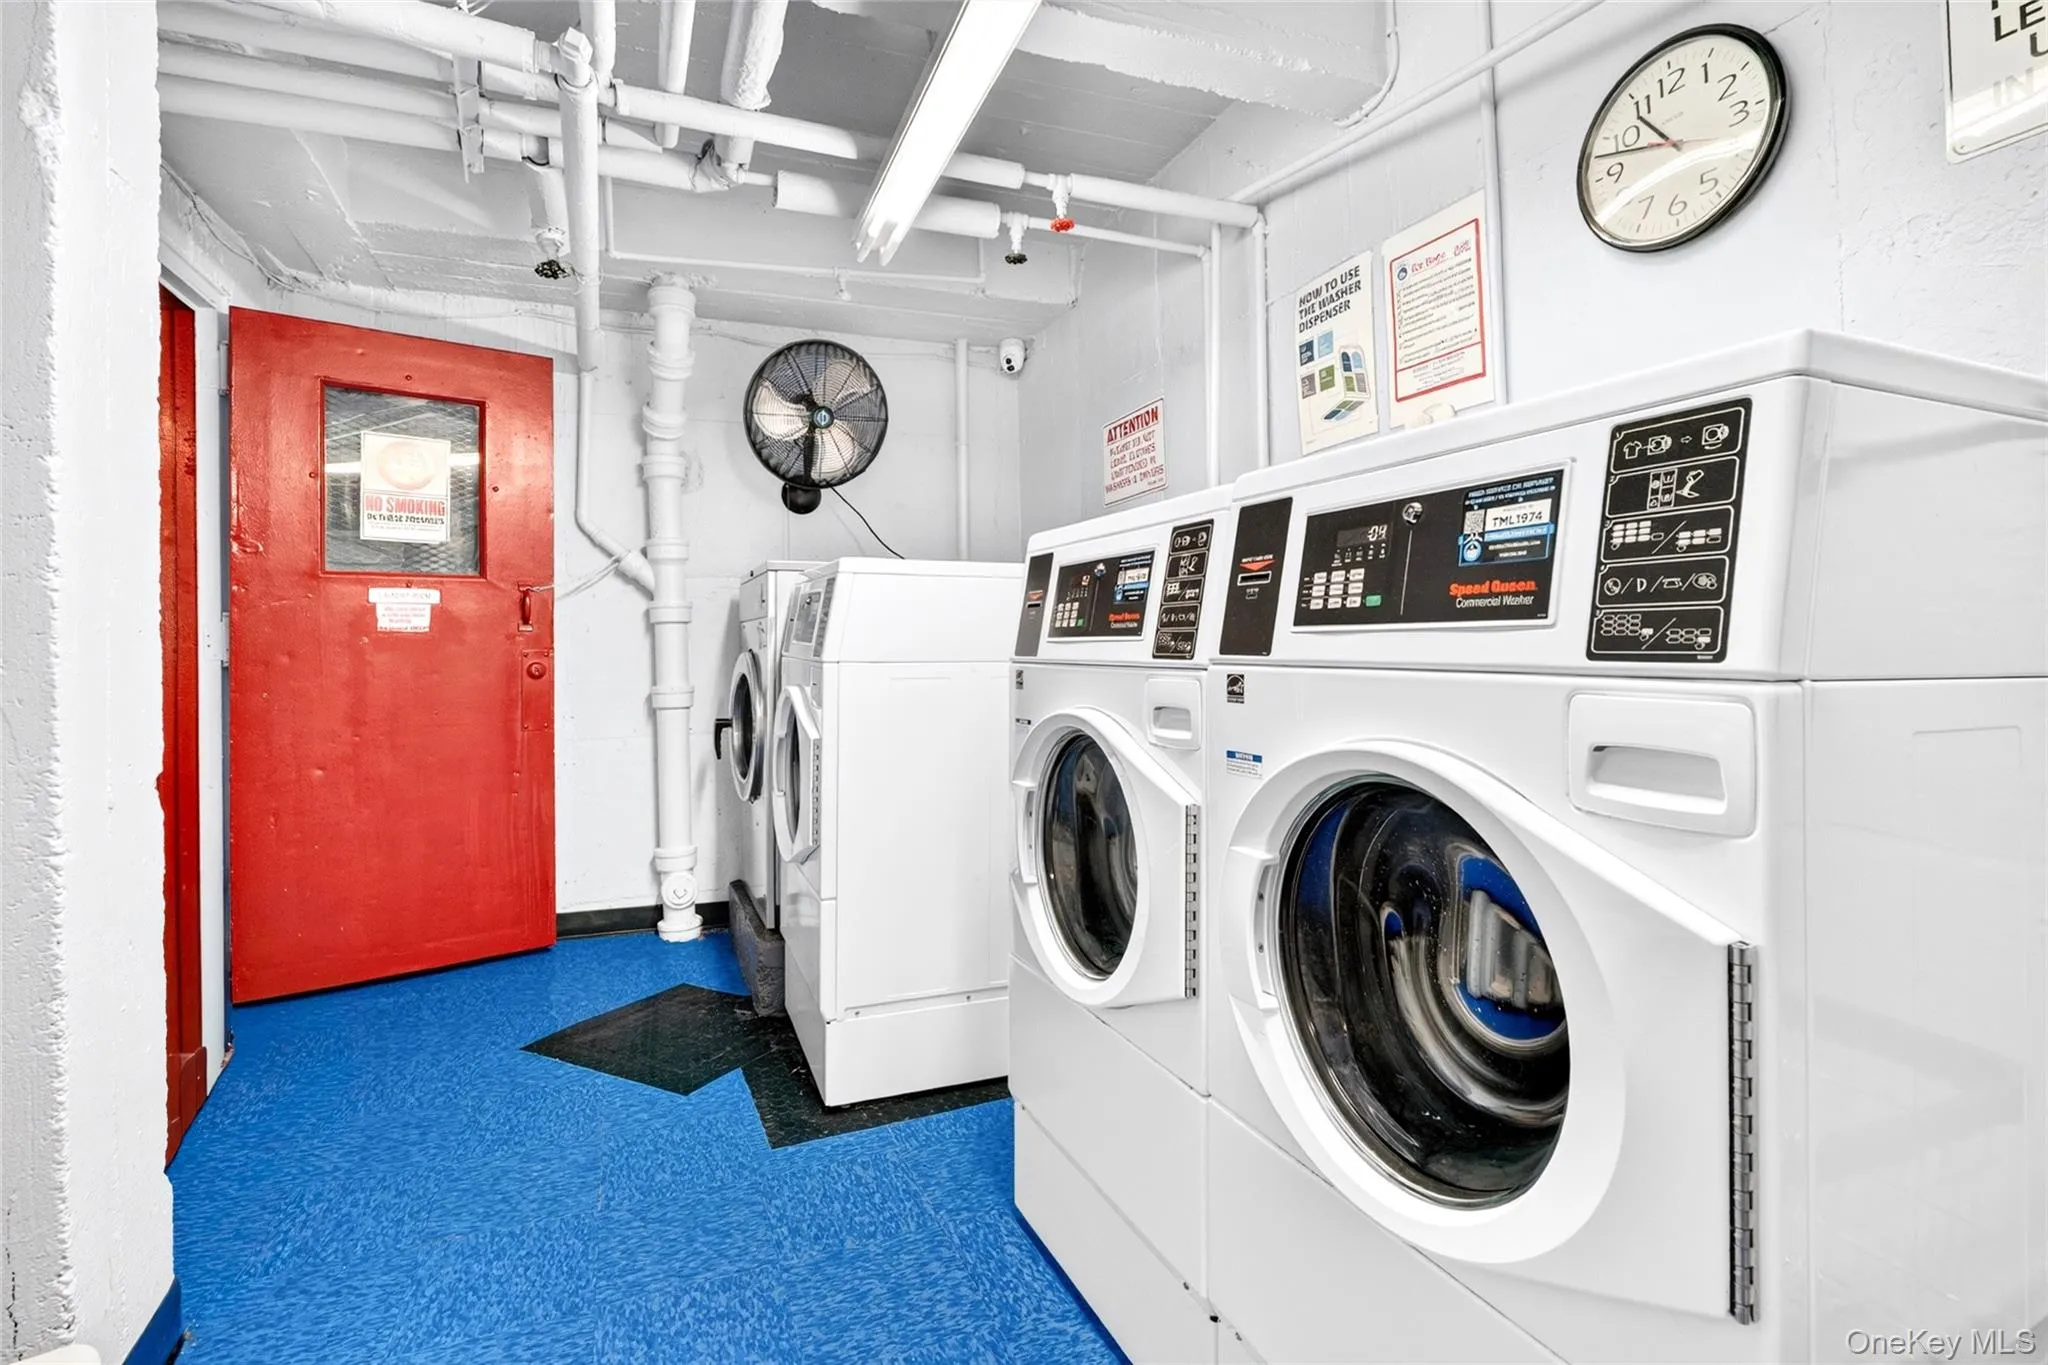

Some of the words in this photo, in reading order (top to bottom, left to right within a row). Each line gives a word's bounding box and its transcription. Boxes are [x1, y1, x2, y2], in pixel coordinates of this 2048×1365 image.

[1657, 66, 1686, 99] 12
[1700, 62, 1711, 84] 1
[1717, 72, 1739, 102] 2
[1632, 92, 1653, 119] 11
[1728, 99, 1750, 128] 3
[1611, 124, 1641, 153] 10
[1606, 162, 1624, 184] 9
[1699, 167, 1720, 196] 5
[1638, 194, 1655, 220] 7
[1667, 192, 1688, 217] 6
[1298, 284, 1323, 309] HOW
[1325, 277, 1338, 293] TO
[1340, 265, 1361, 284] USE
[1299, 303, 1316, 321] THE
[1318, 279, 1362, 310] WASHER
[1298, 299, 1352, 334] DISPENSER
[1107, 406, 1159, 443] ATTENTION
[365, 495, 383, 512] NO
[386, 496, 445, 516] SMOKING
[1492, 511, 1543, 527] TML1974
[1449, 581, 1490, 597] Speed
[1491, 579, 1537, 593] Queen
[1456, 595, 1501, 608] Commercial
[1502, 594, 1534, 605] Washer
